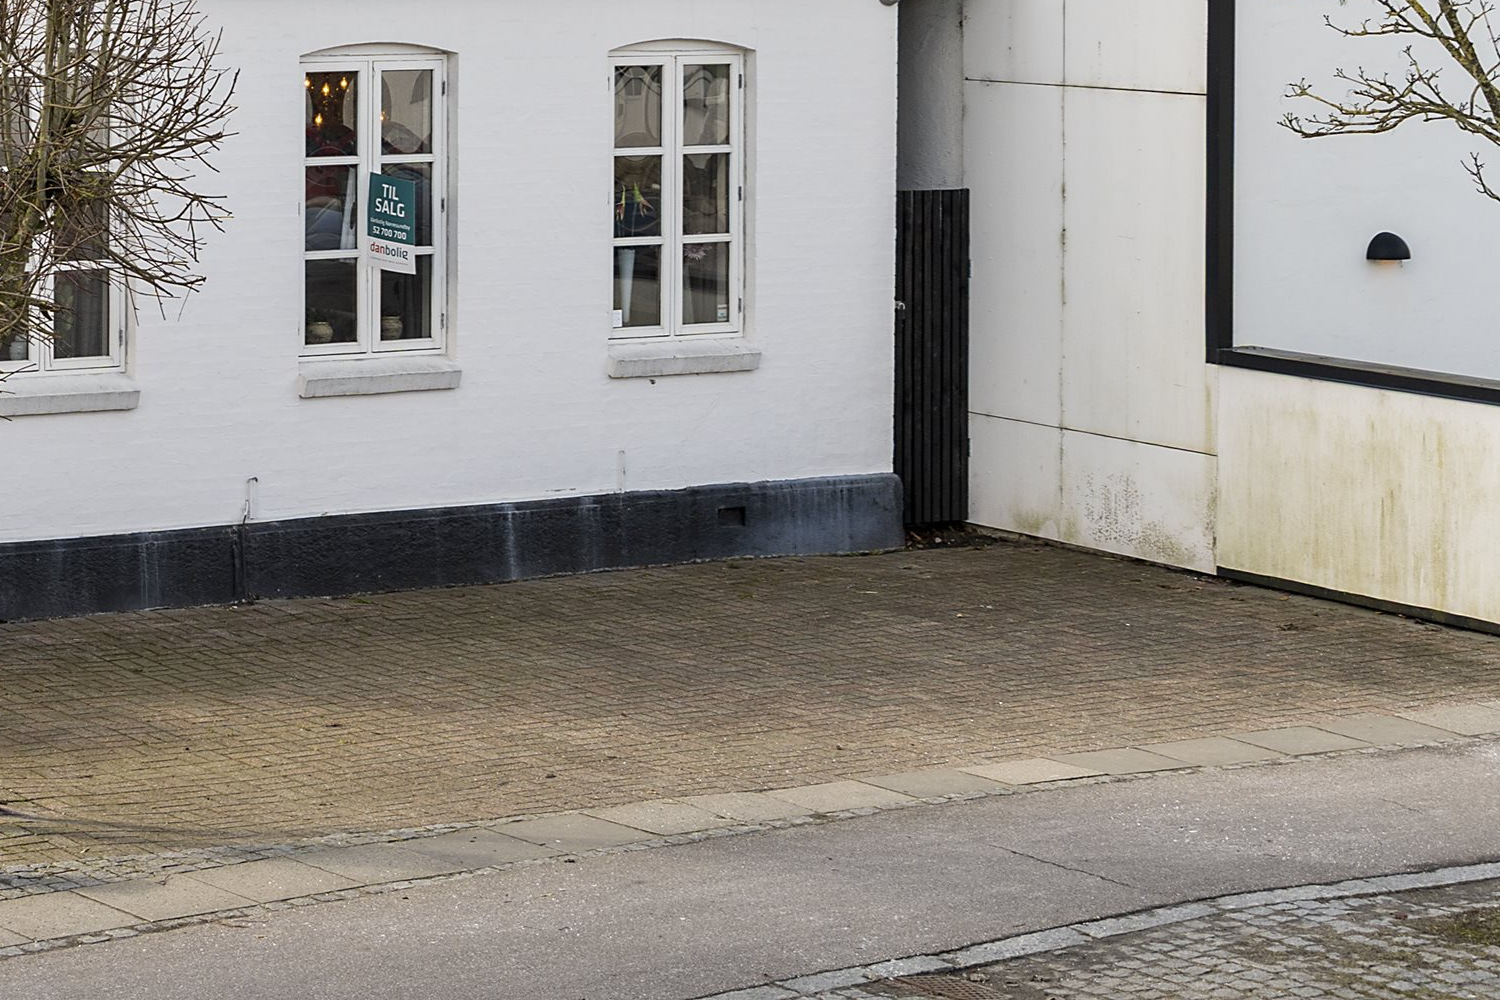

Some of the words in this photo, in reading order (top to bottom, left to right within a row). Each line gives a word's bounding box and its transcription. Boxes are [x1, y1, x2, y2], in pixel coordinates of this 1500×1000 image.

[382, 184, 399, 200] TIL
[375, 199, 405, 217] SALG
[373, 226, 380, 234] 52
[381, 228, 393, 237] 700
[394, 230, 407, 240] 700
[370, 242, 409, 260] danbolig
